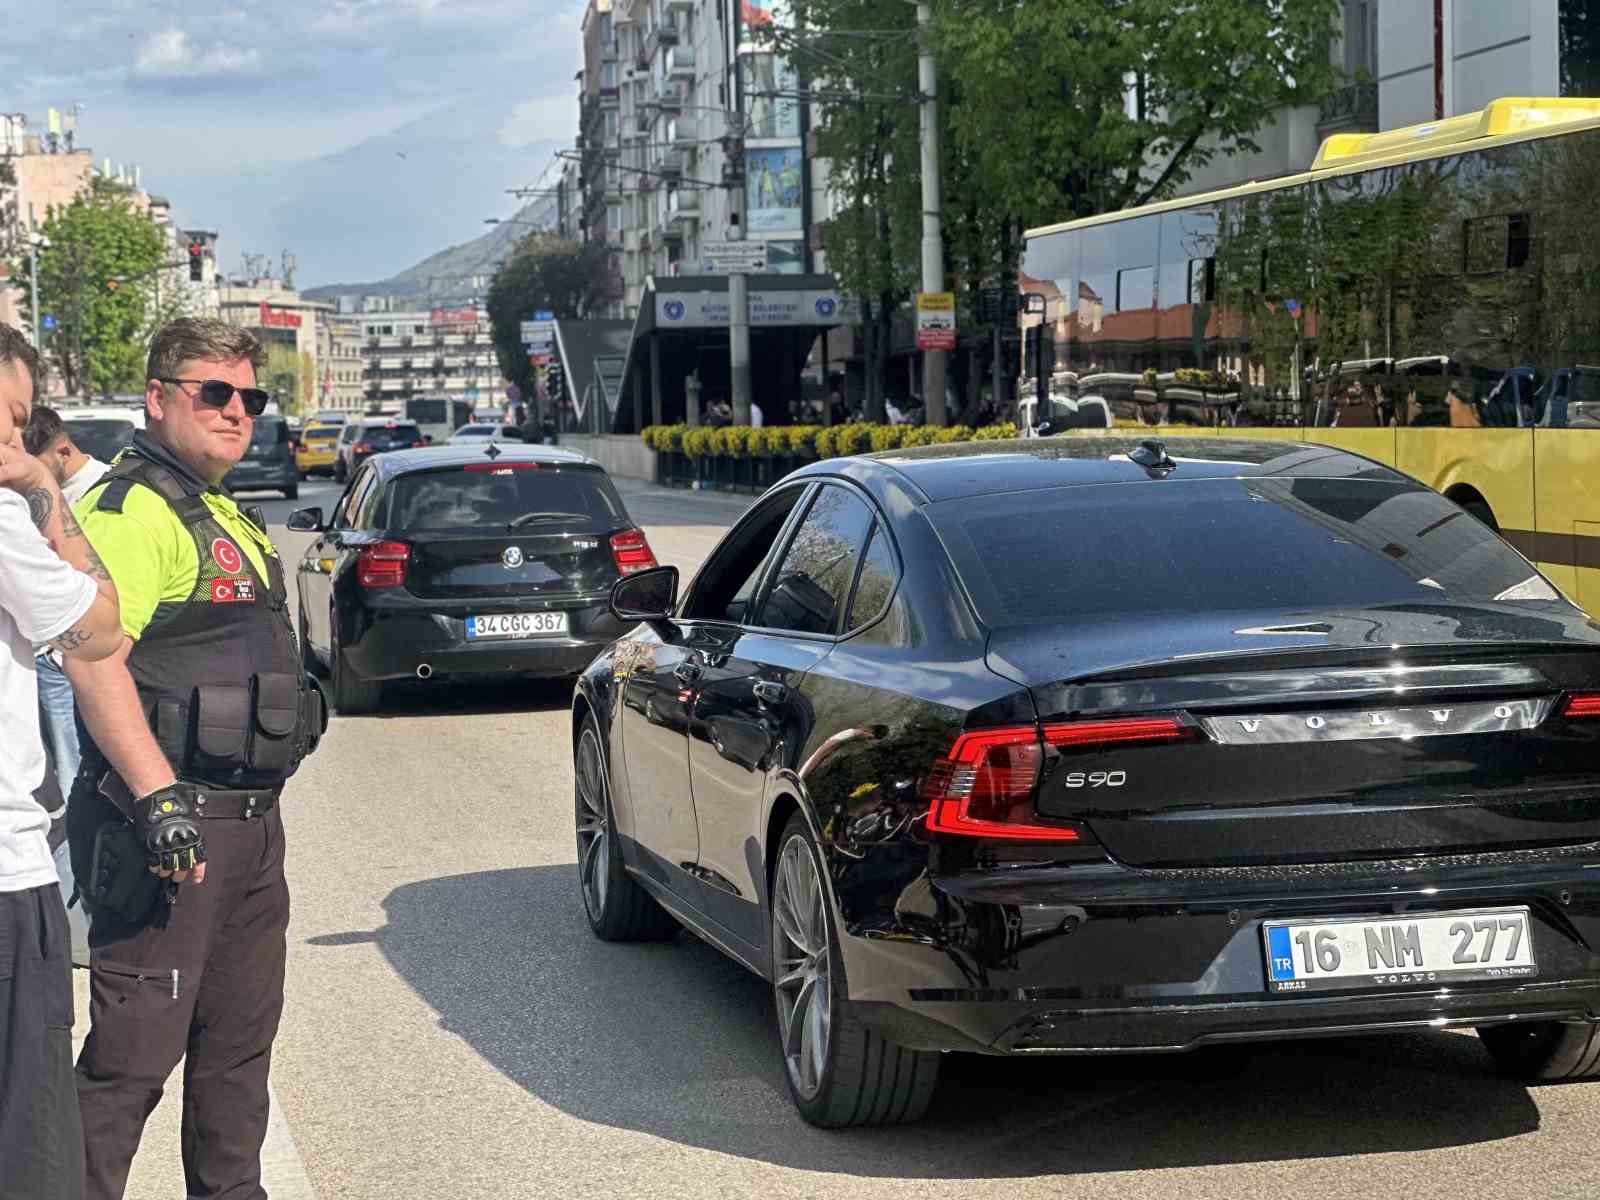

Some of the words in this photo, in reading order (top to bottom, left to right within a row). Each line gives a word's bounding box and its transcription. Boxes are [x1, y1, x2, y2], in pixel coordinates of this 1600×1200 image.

[477, 617, 497, 633] 34
[501, 615, 530, 632] CGC
[534, 613, 564, 630] 367
[1237, 705, 1512, 733] VOLVO
[1065, 771, 1126, 788] S90
[1295, 930, 1341, 974] 16
[1364, 924, 1424, 969] NM
[1449, 919, 1523, 964] 277
[1274, 958, 1292, 970] TR
